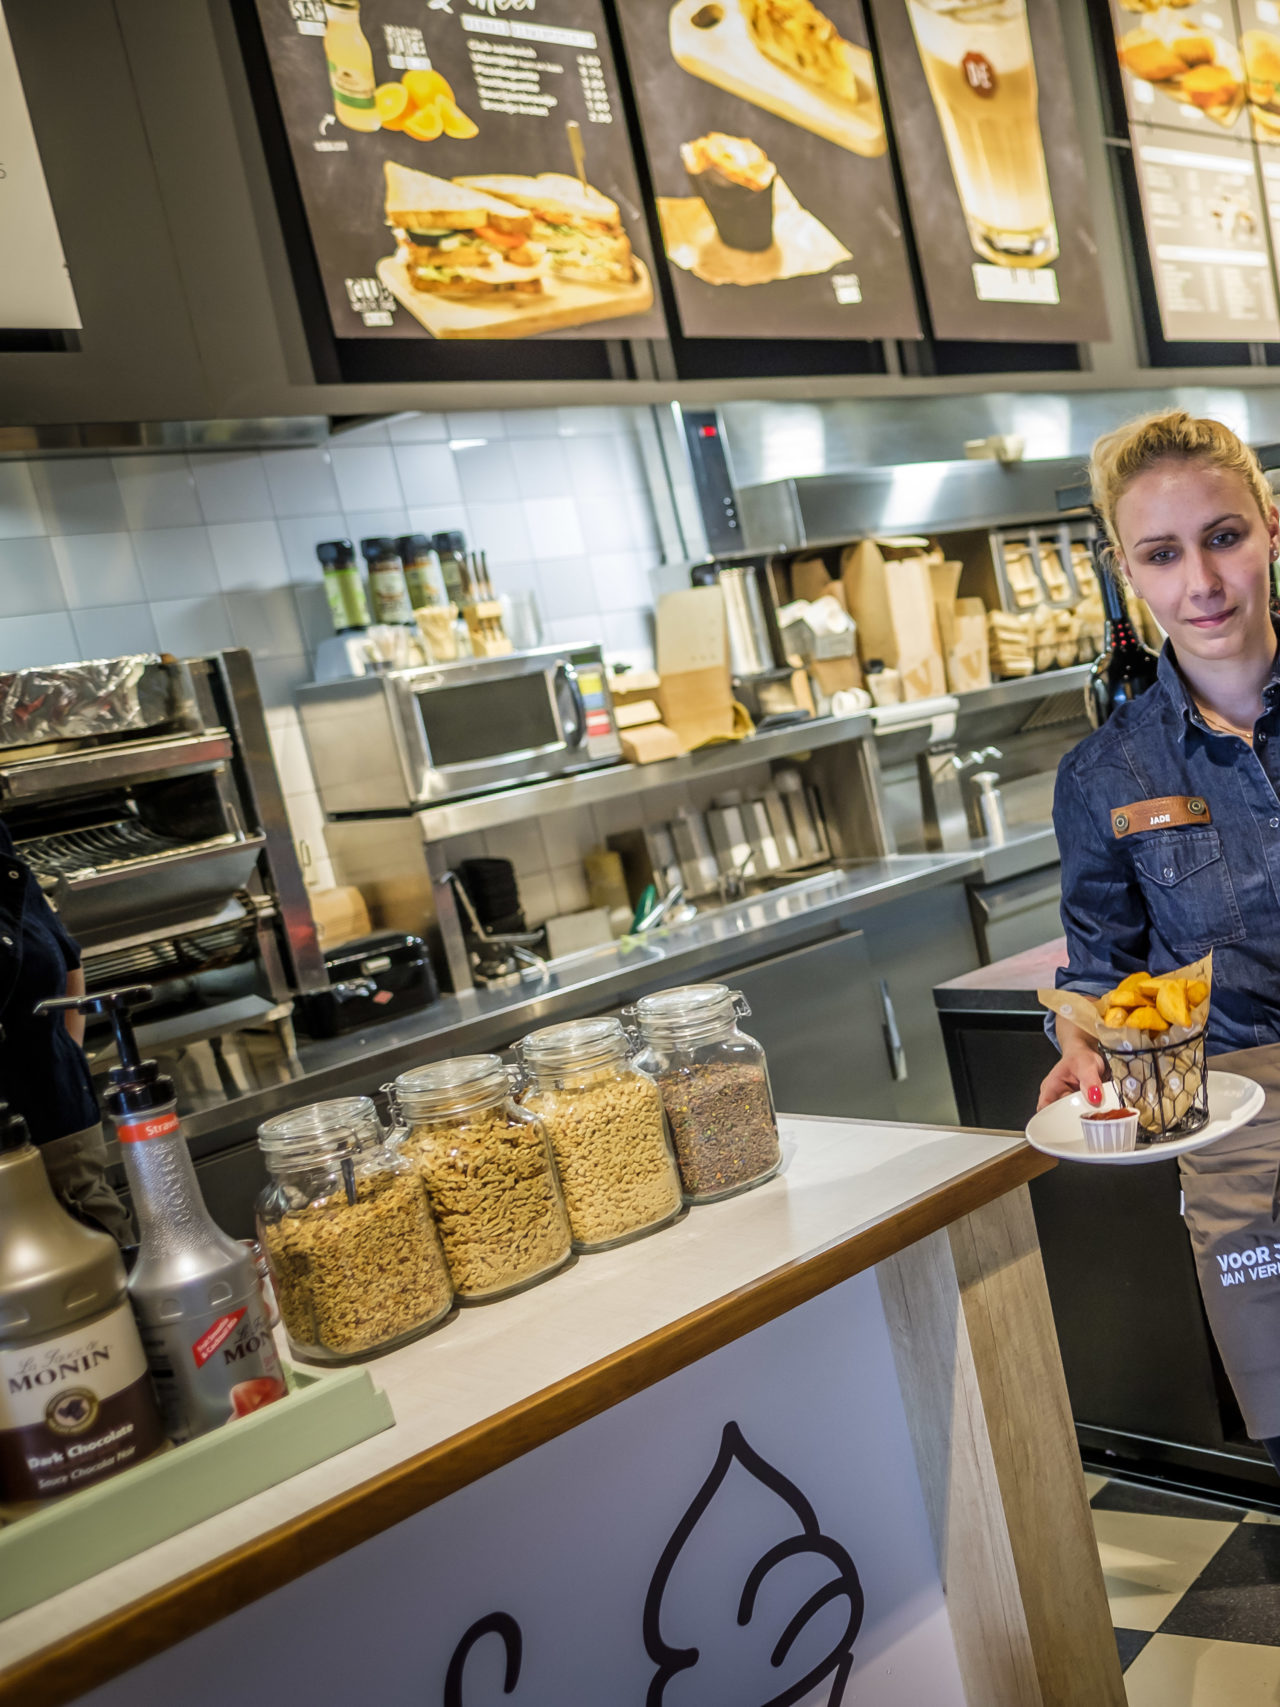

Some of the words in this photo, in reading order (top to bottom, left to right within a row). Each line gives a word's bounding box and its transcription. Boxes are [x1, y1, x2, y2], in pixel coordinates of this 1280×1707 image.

[1150, 814, 1171, 825] JADE
[1216, 1246, 1271, 1272] VOOR
[1220, 1270, 1246, 1287] VAN
[8, 1345, 111, 1394] MONIN
[26, 1451, 65, 1471] Dark
[67, 1423, 135, 1459] Chocolate
